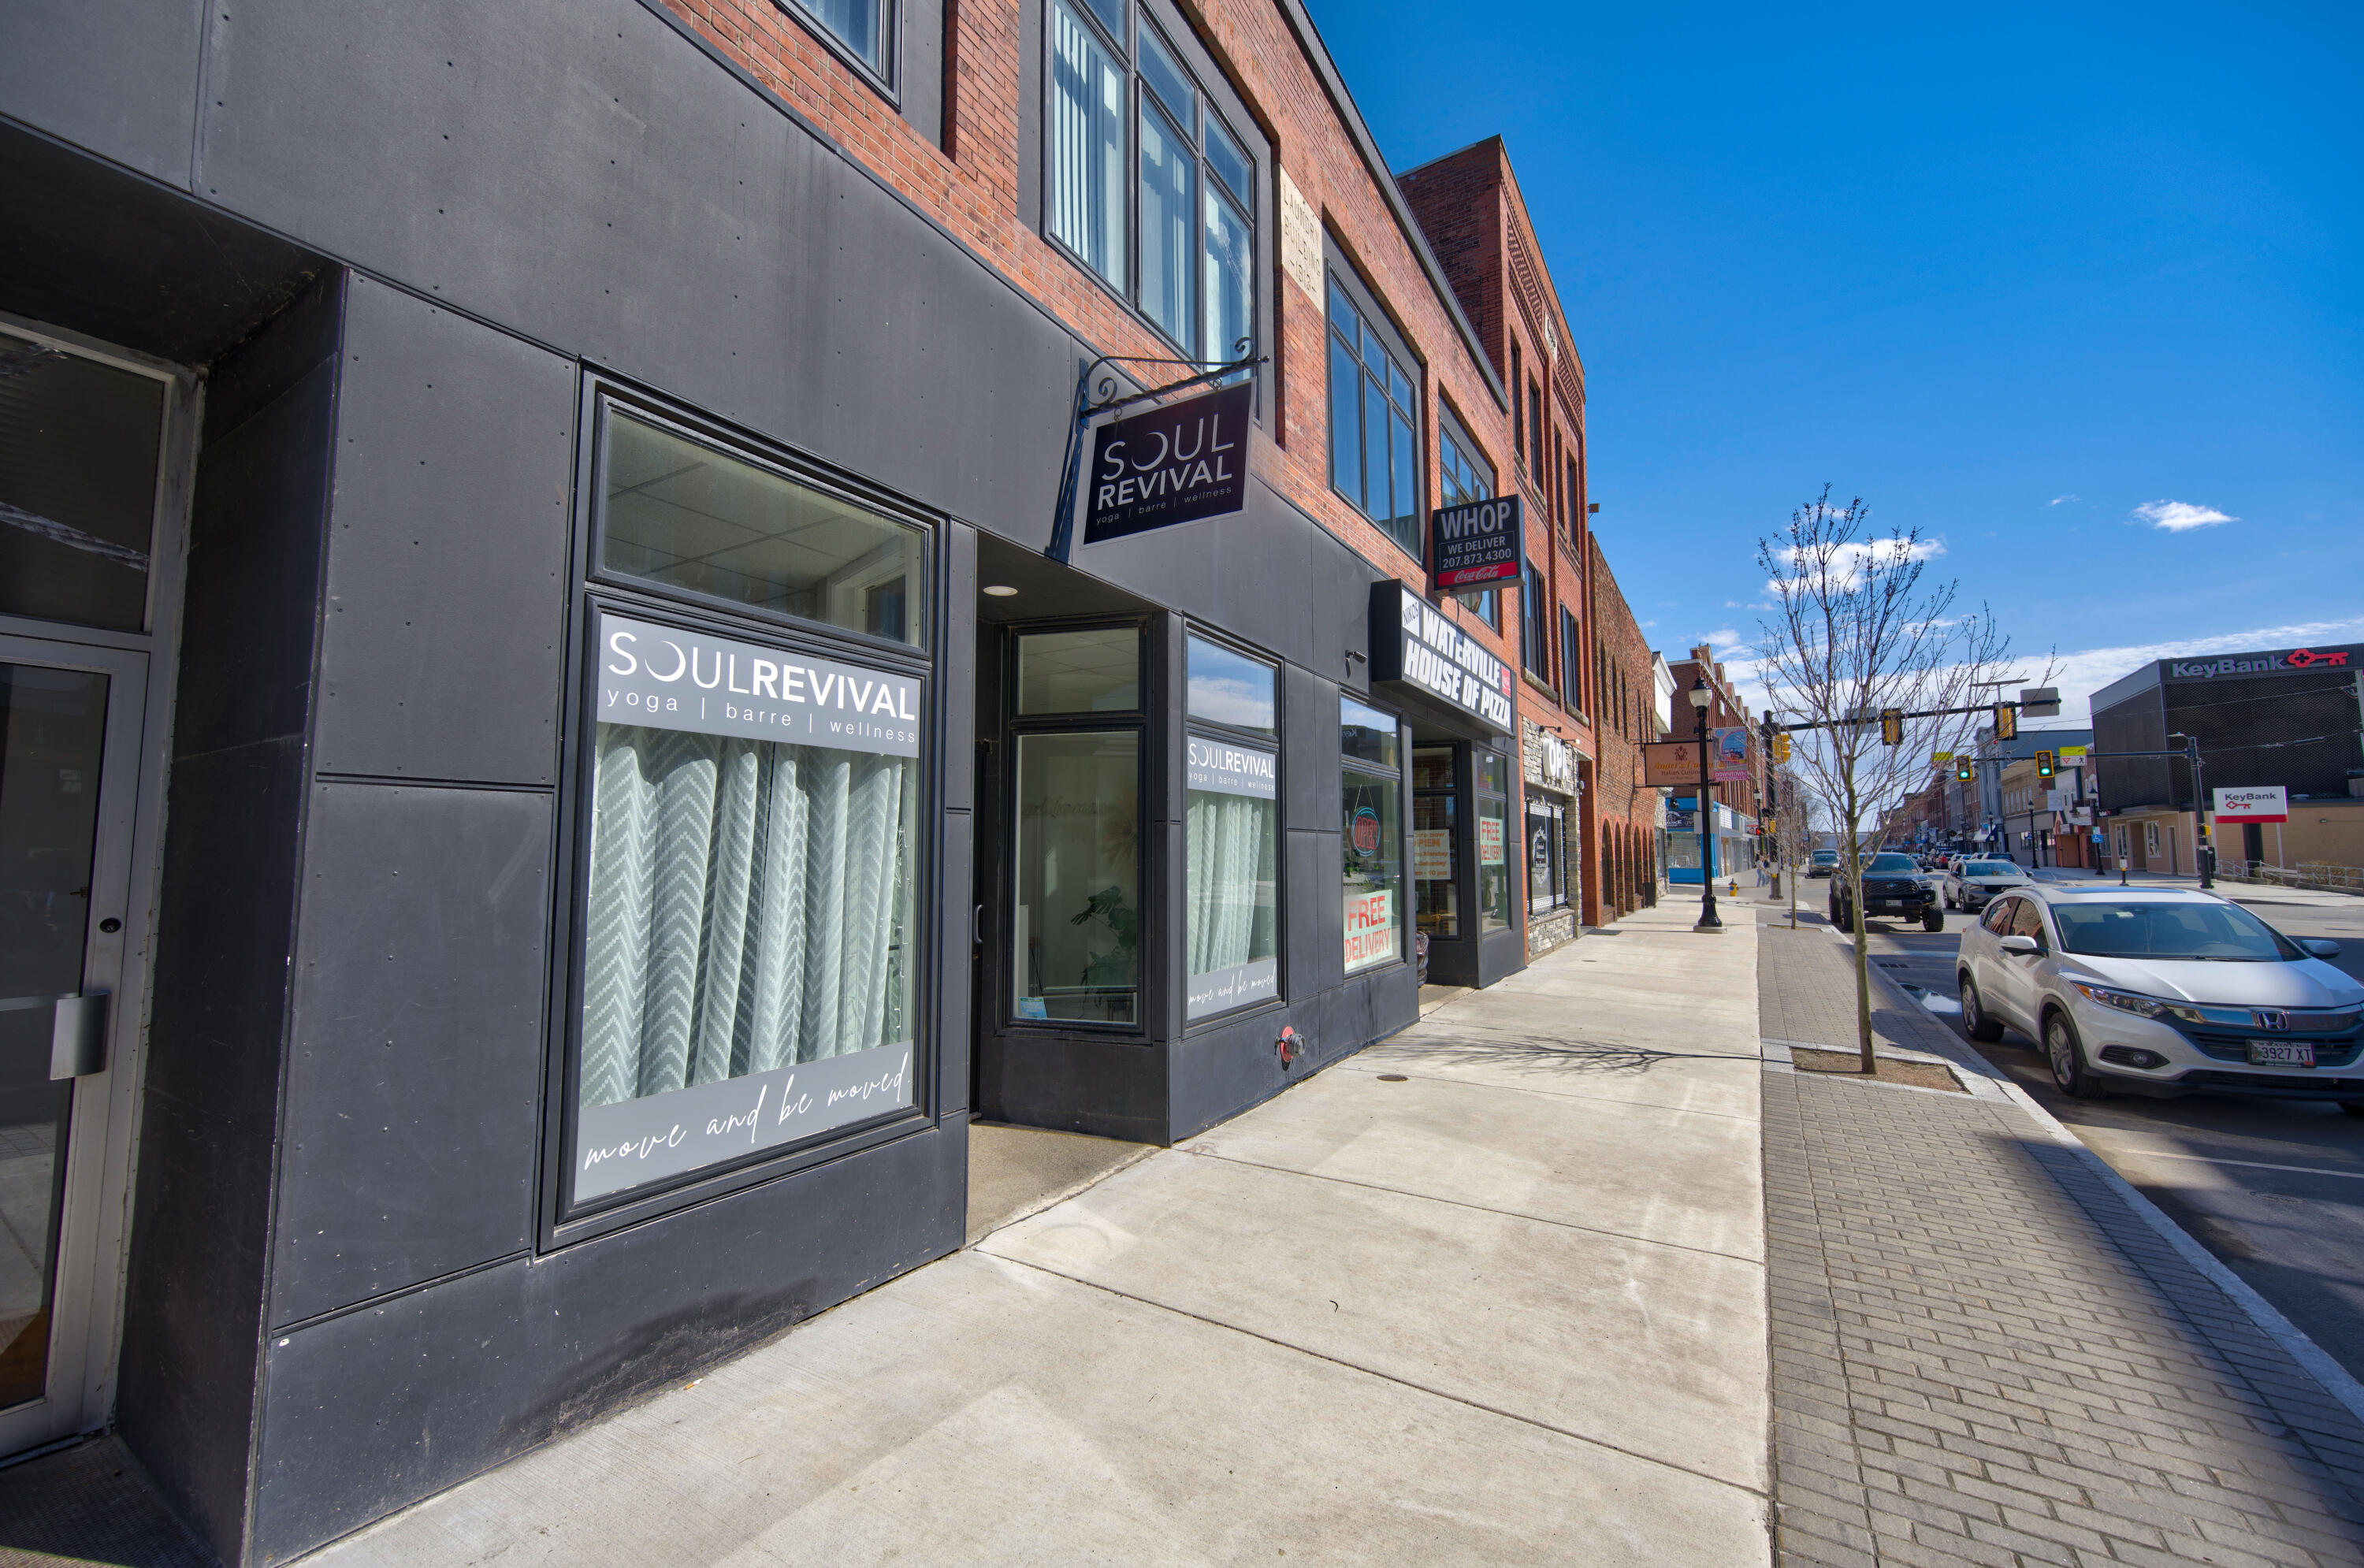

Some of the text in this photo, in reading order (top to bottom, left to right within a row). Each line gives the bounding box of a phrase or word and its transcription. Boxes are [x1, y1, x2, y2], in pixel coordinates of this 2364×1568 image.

[1284, 184, 1320, 249] LAUNDRY
[1284, 214, 1321, 277] BUILDING
[1102, 414, 1234, 481] SOUL
[1097, 455, 1232, 511] REVIVAL
[1096, 512, 1120, 526] yoga
[1139, 501, 1166, 516] barre
[1184, 486, 1232, 503] wellness
[1440, 501, 1511, 540] WHOP
[1443, 548, 1511, 569] 207.873.4300
[1448, 536, 1506, 555] WE DELIVER
[1403, 601, 1418, 626] NIKOS
[1422, 605, 1500, 690] WATERVILLE
[1404, 637, 1462, 701] HOUSE
[1462, 674, 1480, 710] OF
[1480, 685, 1511, 729] PIZZA
[2172, 656, 2284, 678] KeyBank
[607, 687, 678, 712] yoga
[726, 701, 792, 726] barre
[830, 719, 916, 744] wellness
[1189, 772, 1207, 783] yoga
[1219, 775, 1238, 786] barre
[1247, 781, 1274, 791] wellness
[2225, 792, 2277, 801] KeyBank
[1355, 816, 1378, 850] OPEN
[1481, 821, 1500, 841] FREE
[1481, 844, 1503, 860] DELIVERY
[1347, 895, 1385, 932] FREE
[1344, 927, 1391, 964] DELIVERY
[1188, 989, 1214, 1006] move
[1217, 973, 1235, 1004] and
[1237, 969, 1247, 996] be
[2262, 1046, 2310, 1061] 3927 XT
[584, 1124, 687, 1170] move
[705, 1084, 768, 1143] and
[778, 1074, 812, 1125] be
